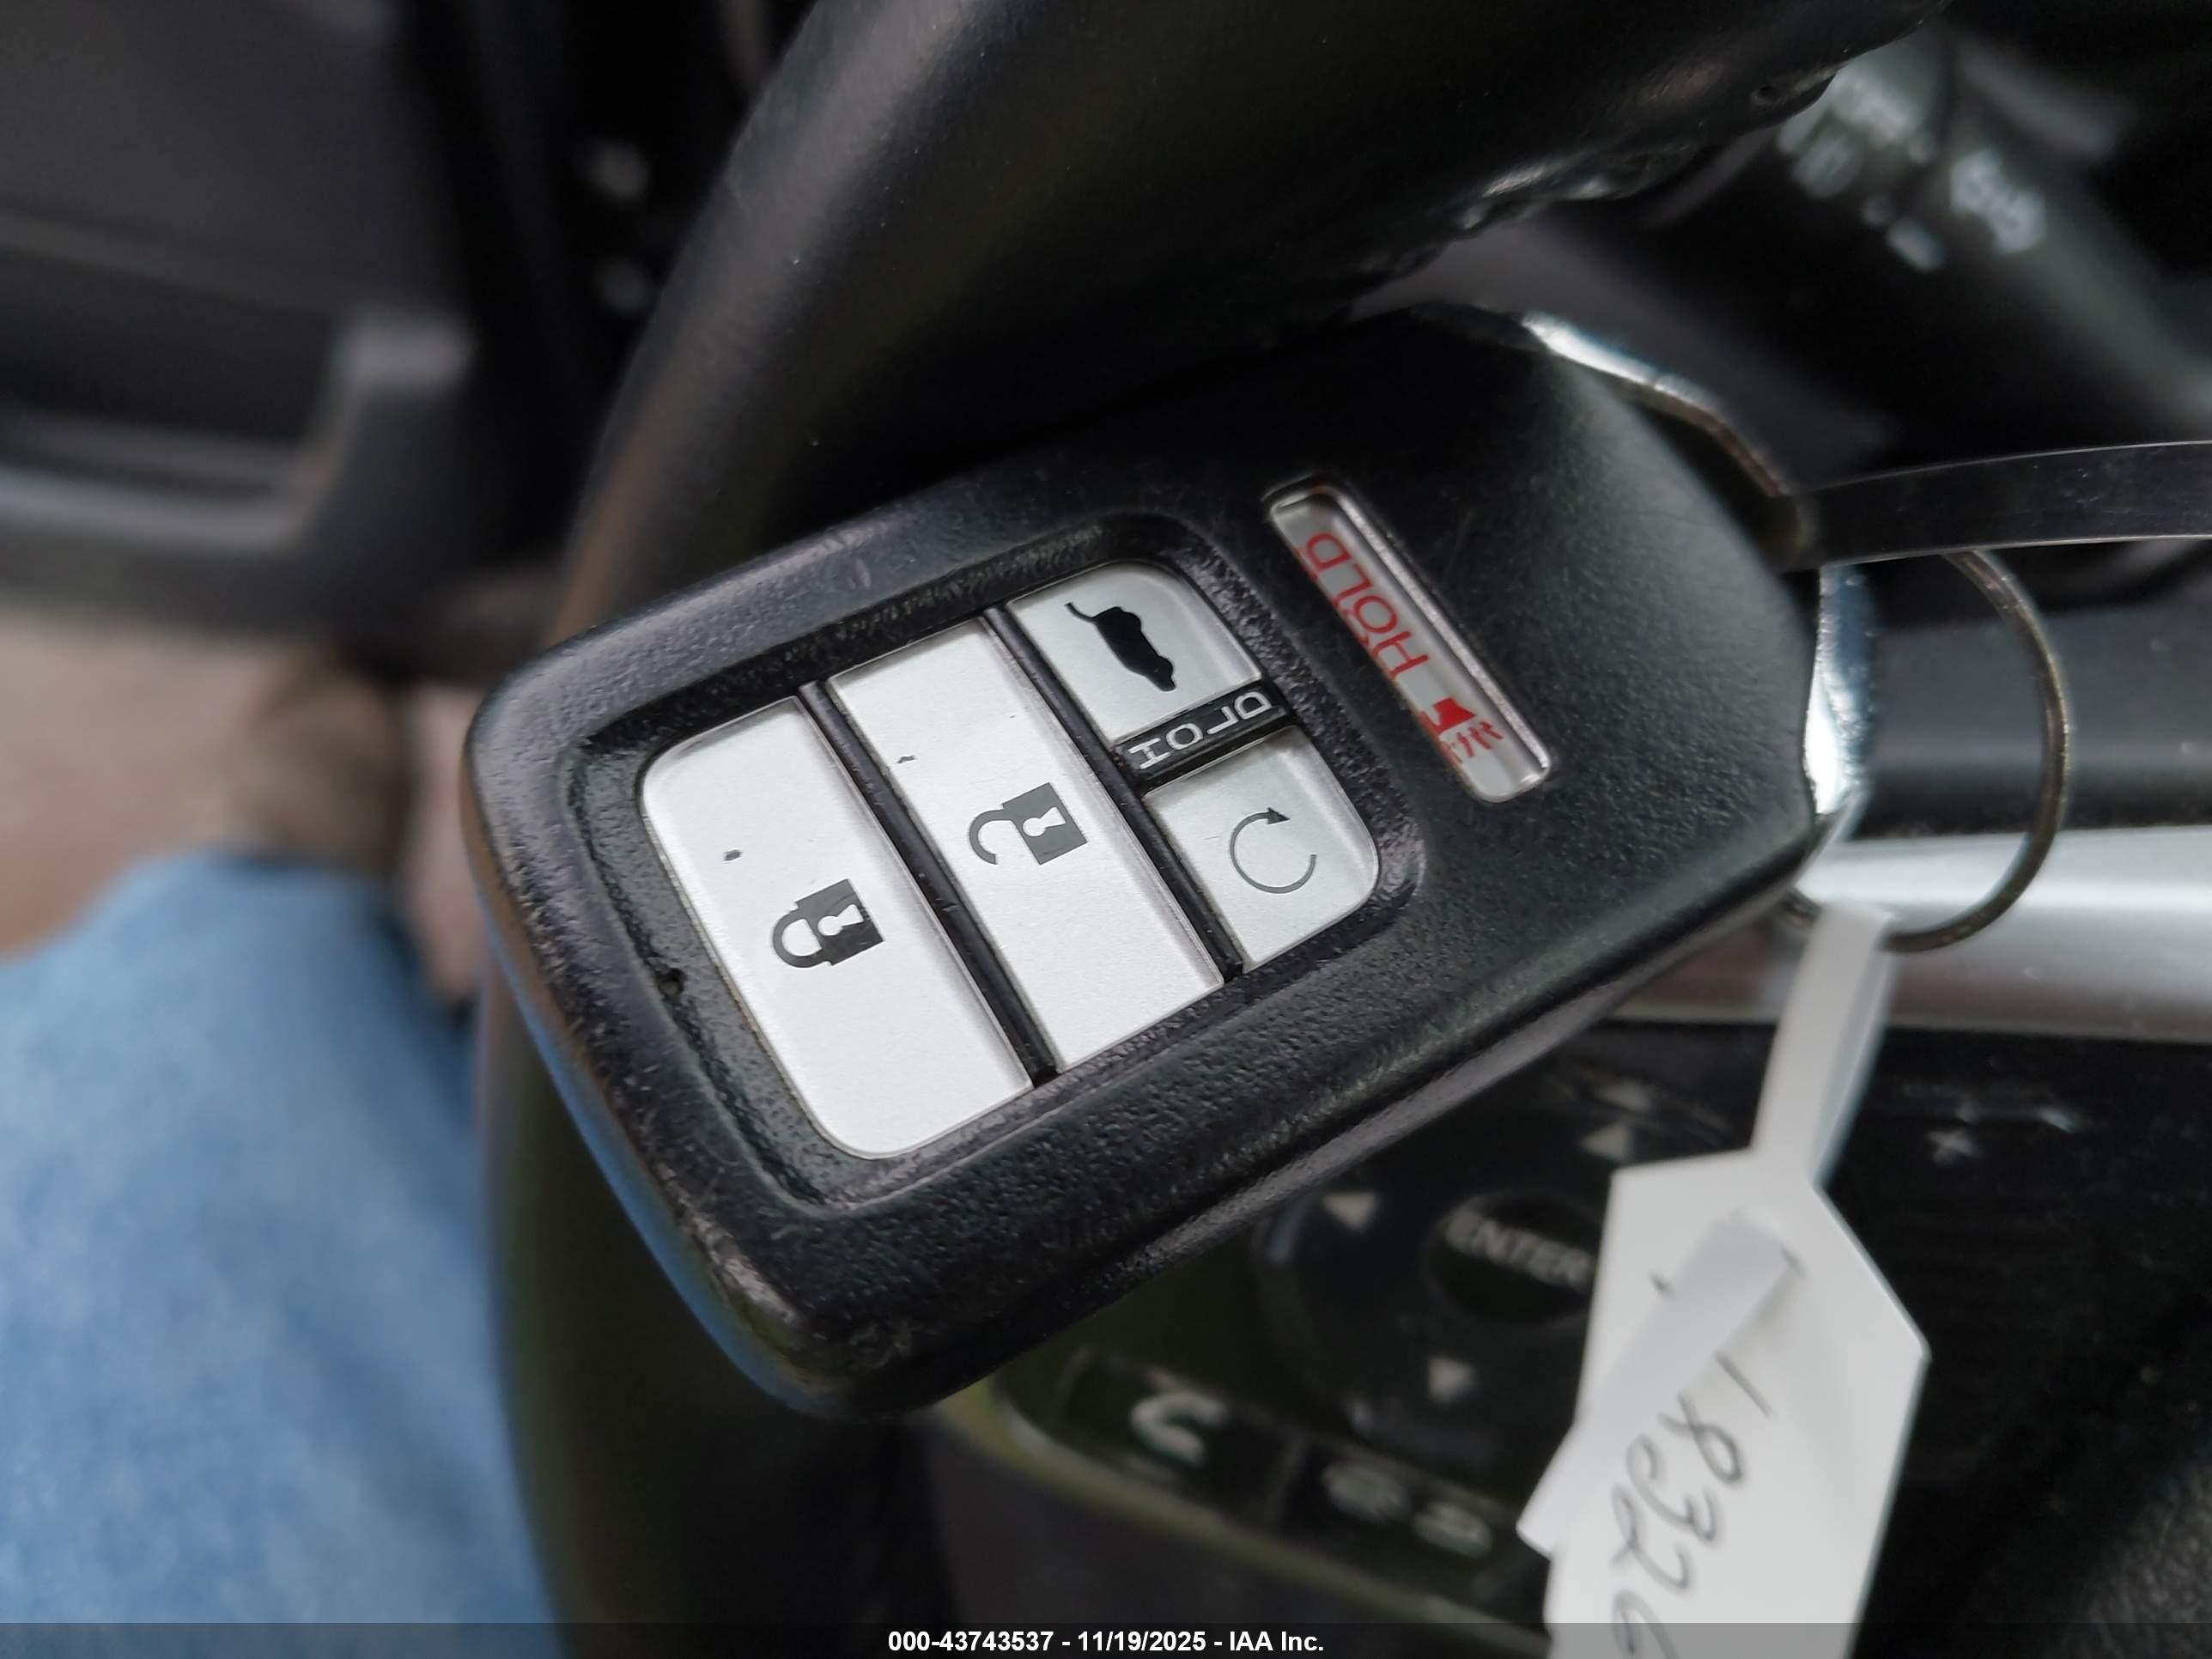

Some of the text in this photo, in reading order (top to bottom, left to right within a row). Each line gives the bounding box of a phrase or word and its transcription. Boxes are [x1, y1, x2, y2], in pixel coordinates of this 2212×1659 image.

[1303, 532, 1430, 678] HOLD
[1127, 690, 1273, 769] HOLD
[1446, 1203, 1595, 1293] ENTER
